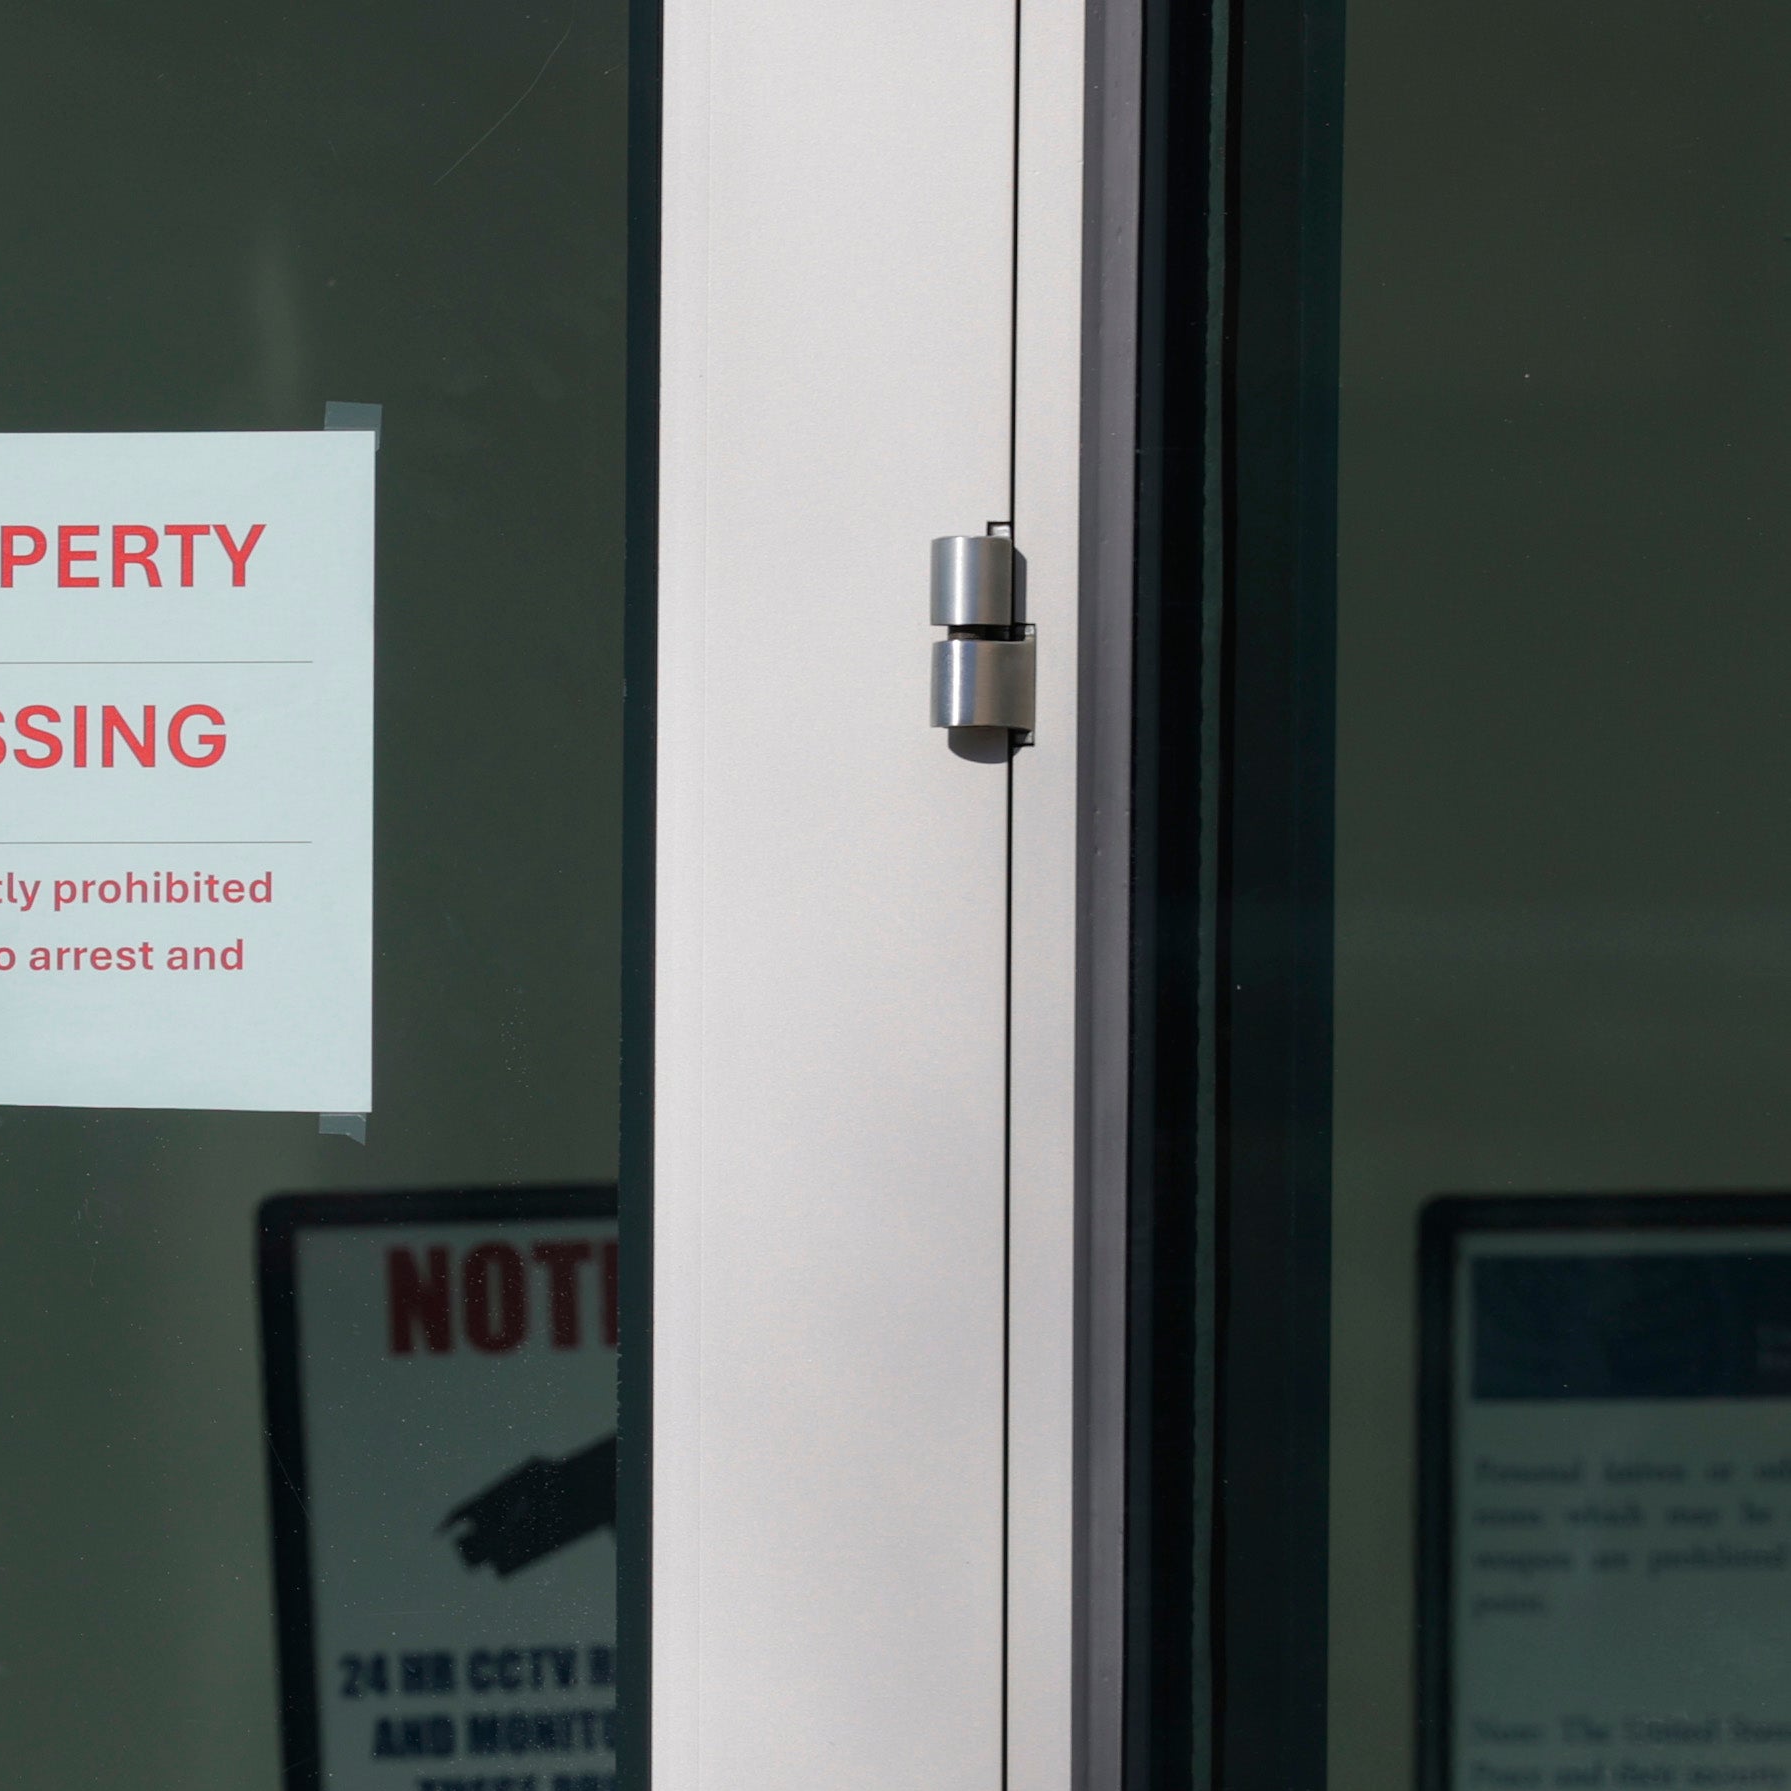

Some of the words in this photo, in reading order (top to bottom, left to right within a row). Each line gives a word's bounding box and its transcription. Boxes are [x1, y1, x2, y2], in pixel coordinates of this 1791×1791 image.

[52, 870, 273, 911] prohibited
[28, 942, 154, 972] arrest
[165, 937, 246, 971] and
[340, 1653, 388, 1699] 24
[468, 1645, 576, 1692] CCTV
[374, 1715, 455, 1759] AND
